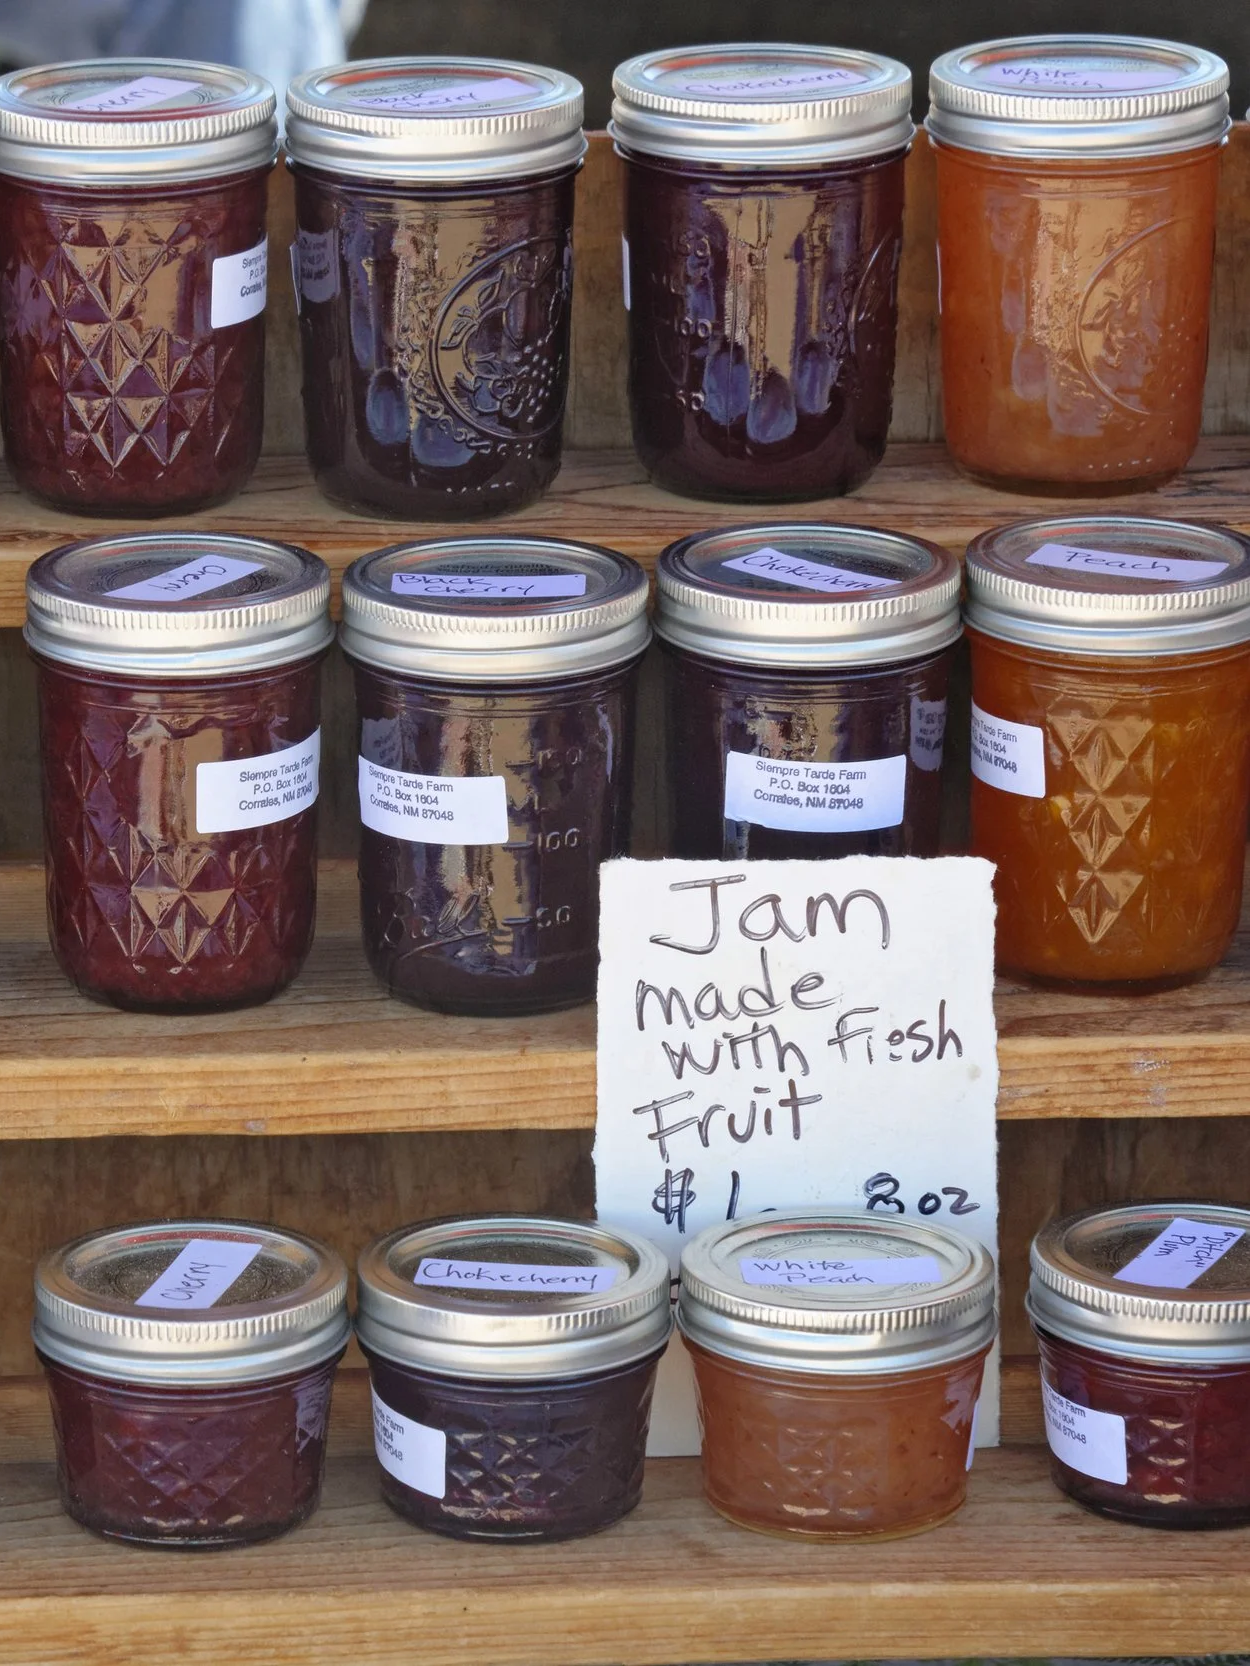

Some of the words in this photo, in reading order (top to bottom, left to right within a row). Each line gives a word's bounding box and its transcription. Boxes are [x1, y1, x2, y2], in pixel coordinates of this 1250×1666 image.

[1064, 550, 1171, 573] Peach
[148, 564, 227, 592] Cherry
[396, 574, 492, 586] Black
[424, 584, 536, 596] Cherry
[996, 728, 1018, 743] Farm
[239, 768, 278, 783] Siempre
[279, 761, 300, 776] Tarde
[301, 753, 314, 769] Farm
[368, 765, 396, 784] Siempre
[397, 775, 424, 790] Tarde
[426, 780, 454, 792] Farm
[755, 759, 800, 777] Siempre
[803, 767, 836, 780] Tarde
[838, 769, 867, 780] Farm
[276, 778, 292, 791] Box
[395, 788, 412, 802] Box
[769, 777, 794, 791] P.O.
[797, 780, 820, 794] Box
[282, 790, 296, 804] NM
[753, 788, 803, 809] Corrales,
[805, 795, 826, 809] NM
[828, 797, 864, 810] 87048
[403, 804, 420, 818] NM
[421, 808, 454, 821] 87048
[649, 872, 891, 956] Jam
[635, 946, 845, 1032] made
[662, 1020, 811, 1080] with
[632, 1077, 824, 1164] Fruit
[1153, 1233, 1197, 1258] Plum
[422, 1261, 599, 1291] Chokecherry
[753, 1259, 855, 1272] White
[159, 1260, 228, 1302] Cherry
[778, 1272, 876, 1285] Peach
[1065, 1400, 1087, 1418] Farm
[1062, 1425, 1087, 1445] 87048
